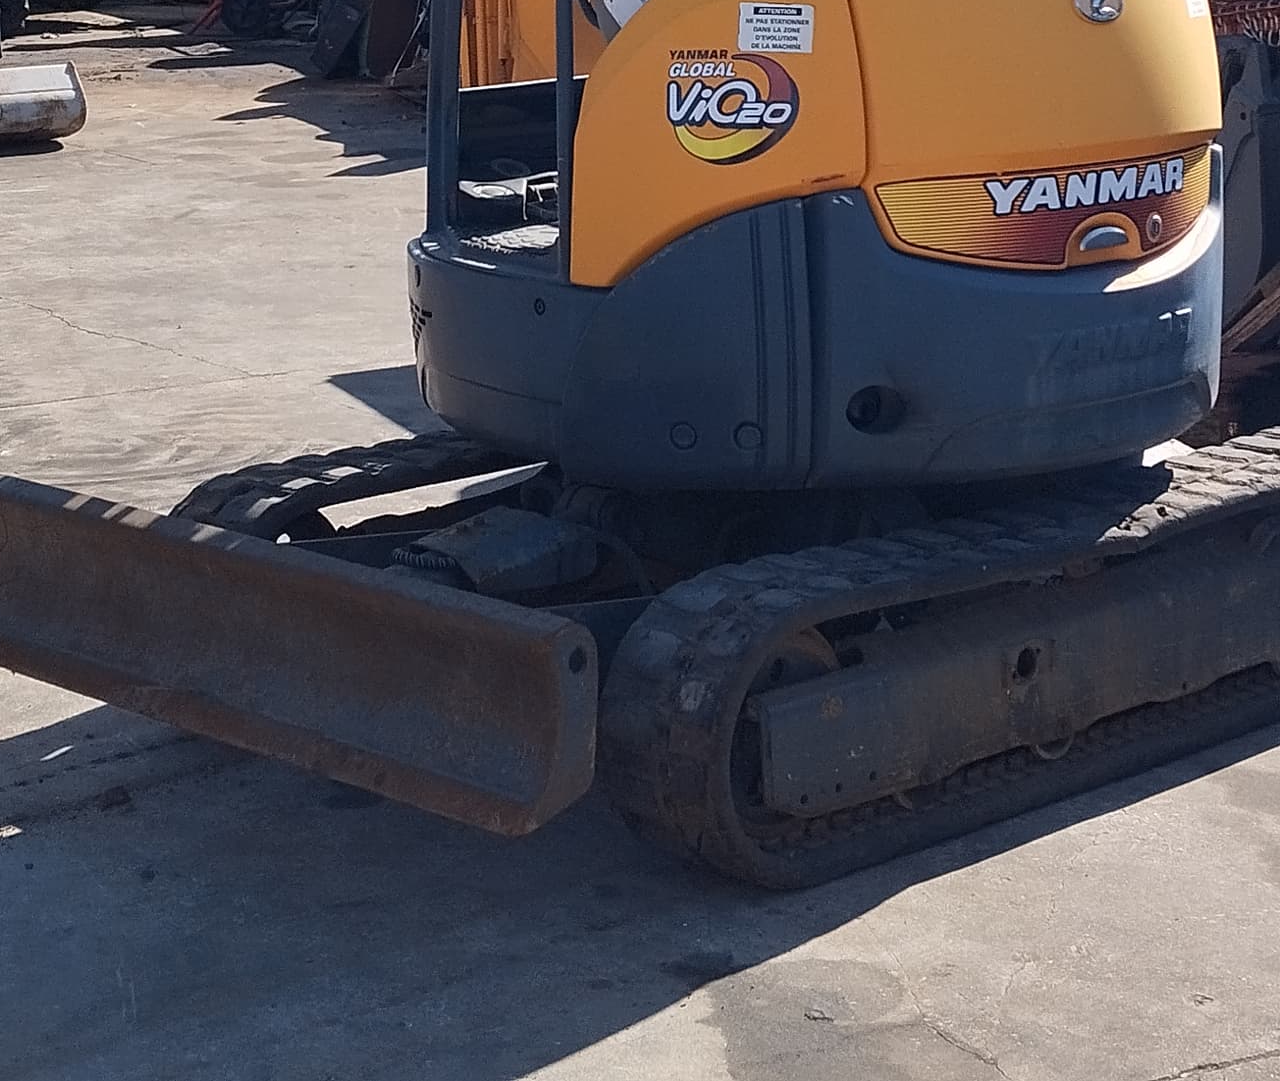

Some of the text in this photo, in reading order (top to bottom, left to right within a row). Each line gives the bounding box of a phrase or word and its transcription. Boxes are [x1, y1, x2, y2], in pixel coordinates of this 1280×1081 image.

[757, 7, 798, 15] ATTENTION
[669, 50, 728, 60] YANMAR
[669, 62, 736, 77] GLOBAL
[984, 157, 1185, 215] YANMAR
